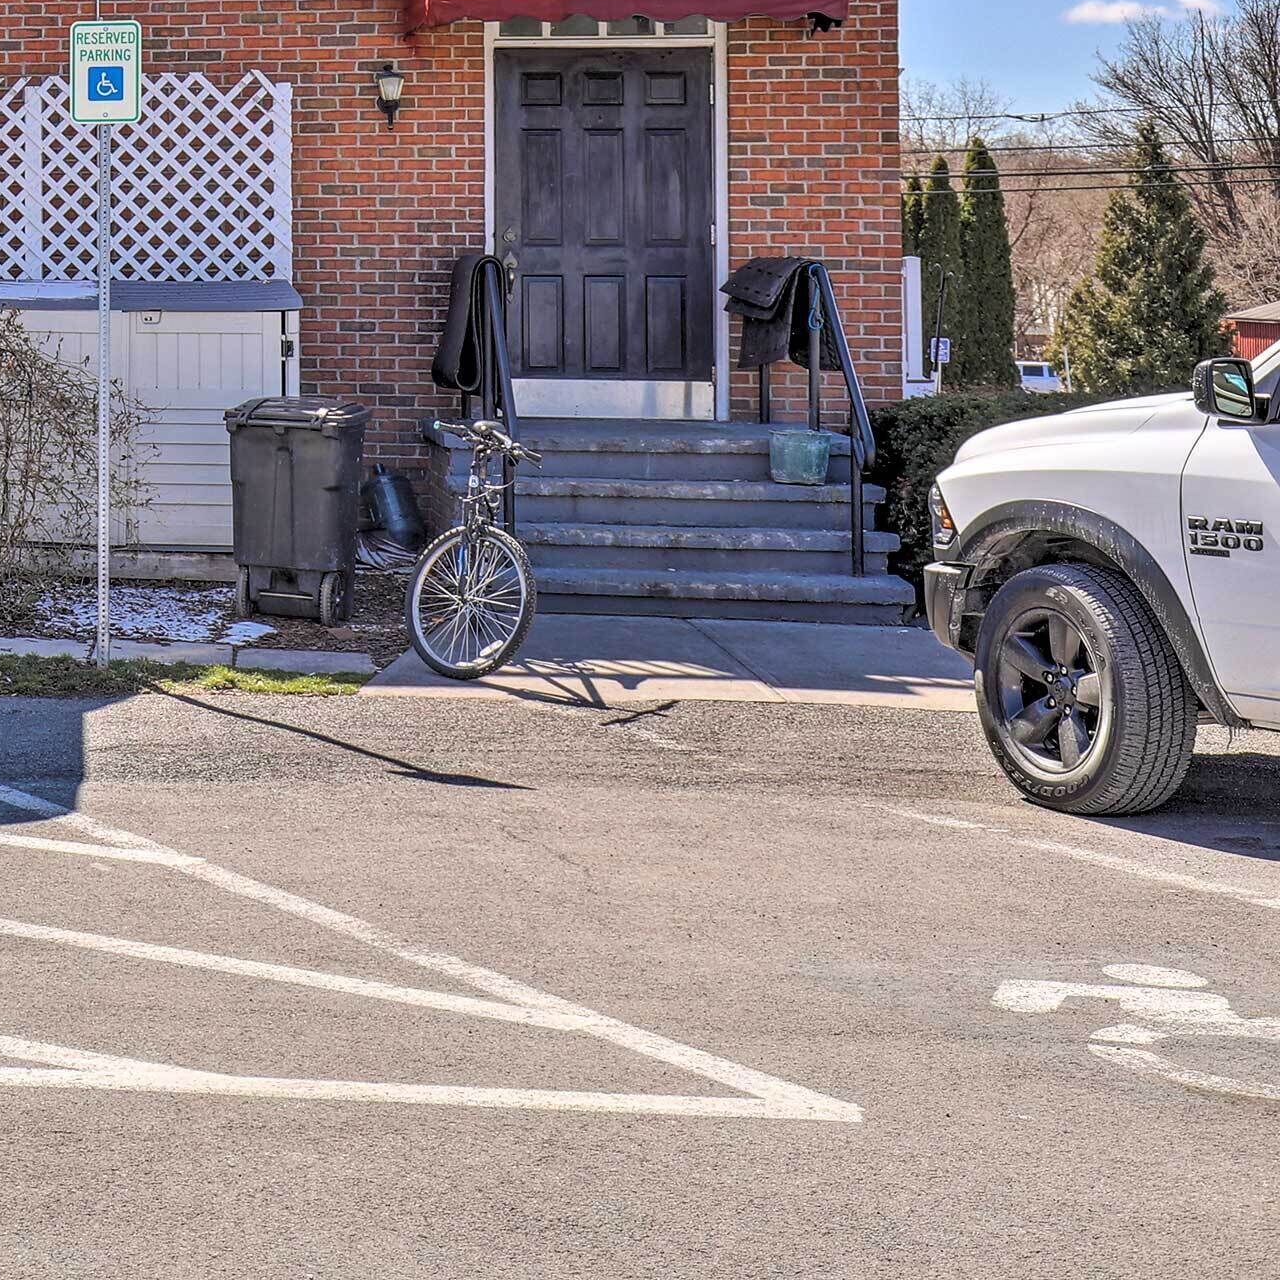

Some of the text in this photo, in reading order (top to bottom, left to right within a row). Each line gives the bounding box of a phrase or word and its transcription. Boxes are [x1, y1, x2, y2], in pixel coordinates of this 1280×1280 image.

[76, 31, 136, 45] RESERVED
[80, 48, 132, 62] PARKING
[1187, 515, 1263, 536] RAM
[1188, 531, 1264, 551] 1500
